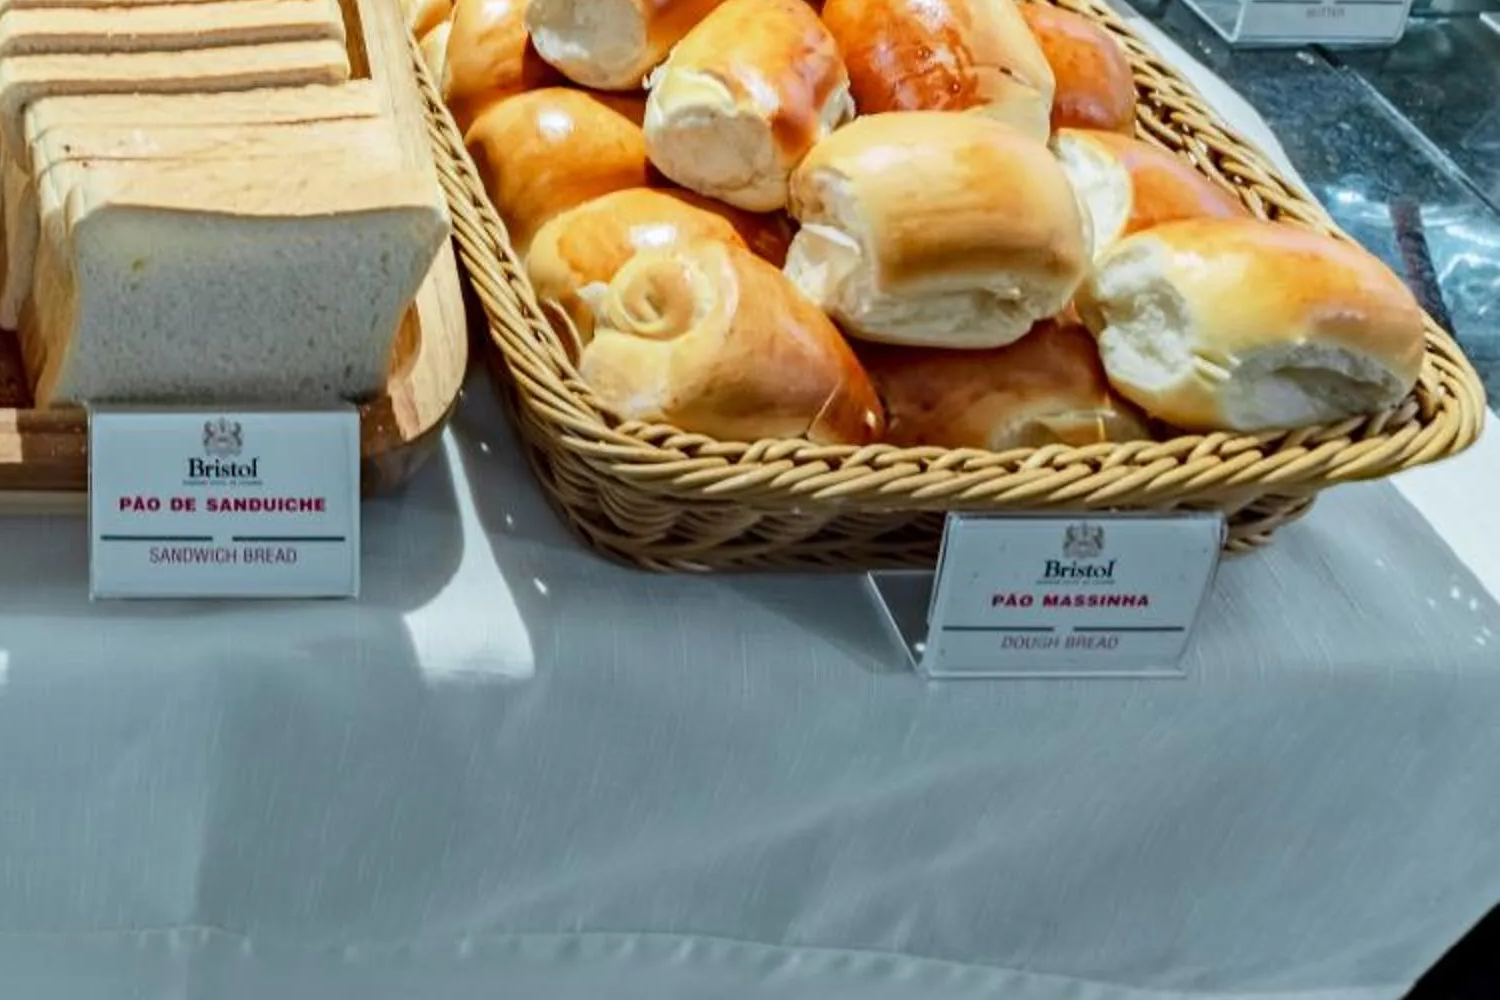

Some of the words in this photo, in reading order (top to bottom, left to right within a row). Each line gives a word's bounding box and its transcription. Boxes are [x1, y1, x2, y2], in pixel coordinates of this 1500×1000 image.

[188, 457, 259, 478] Bristol
[119, 496, 160, 512] PÃO
[170, 497, 196, 512] DE
[207, 497, 326, 512] SANDUICHE
[149, 547, 238, 564] SANDWICH
[243, 547, 297, 564] BREAD
[1043, 559, 1118, 579] Bristol
[991, 592, 1033, 607] PÃO
[1042, 593, 1150, 607] MASSINHA
[1001, 636, 1060, 650] DOUGH
[1064, 636, 1119, 650] BREAD
